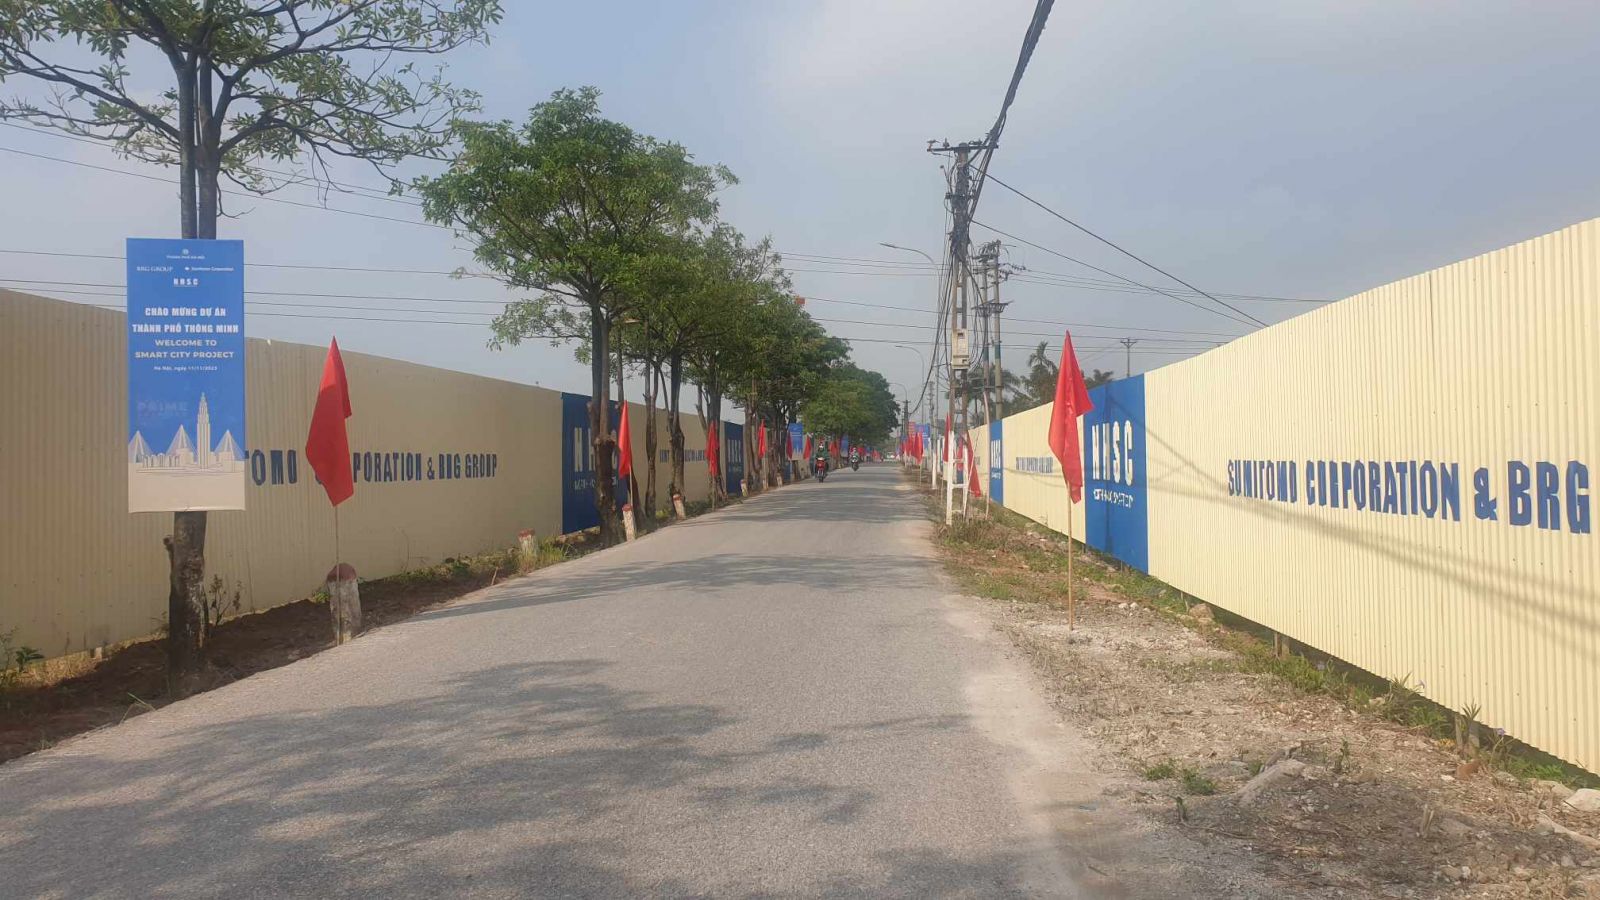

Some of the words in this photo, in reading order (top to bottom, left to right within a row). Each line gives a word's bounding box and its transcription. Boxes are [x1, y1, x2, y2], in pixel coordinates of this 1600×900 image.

[216, 324, 239, 333] MINH
[155, 339, 202, 347] WELCOME
[206, 339, 217, 347] TO
[427, 457, 435, 480] &
[465, 453, 497, 478] GROUP
[1092, 420, 1133, 486] NHSC
[1228, 459, 1297, 503] SUMITOMO
[1306, 460, 1461, 522] CORPORATION
[1474, 467, 1498, 521] &
[1507, 460, 1591, 534] BRG
